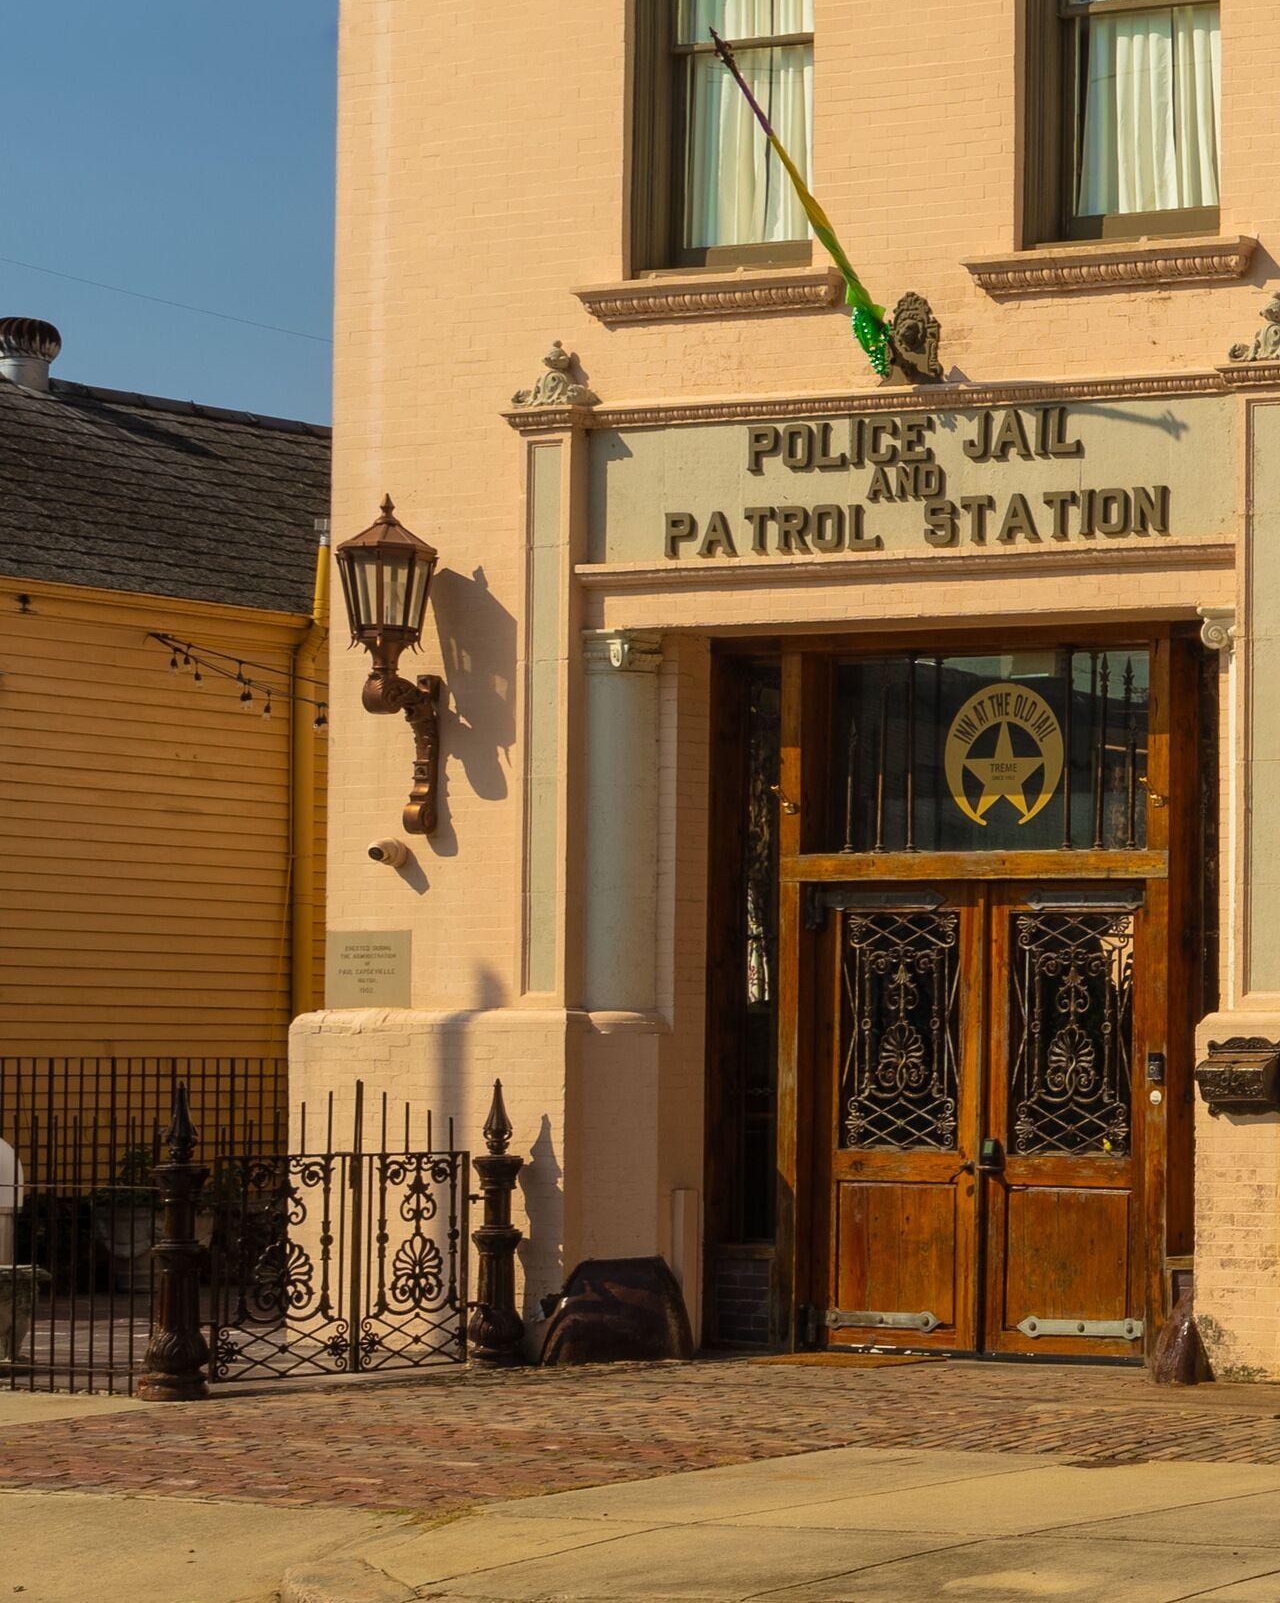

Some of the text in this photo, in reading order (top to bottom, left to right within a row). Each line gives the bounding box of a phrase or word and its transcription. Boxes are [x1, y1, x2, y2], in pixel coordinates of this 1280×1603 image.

[747, 406, 1084, 475] POLICE JAIL
[867, 464, 946, 503] AND
[665, 485, 1171, 560] PATROL STATION
[953, 692, 1057, 745] INN AT THE OLD JAIL
